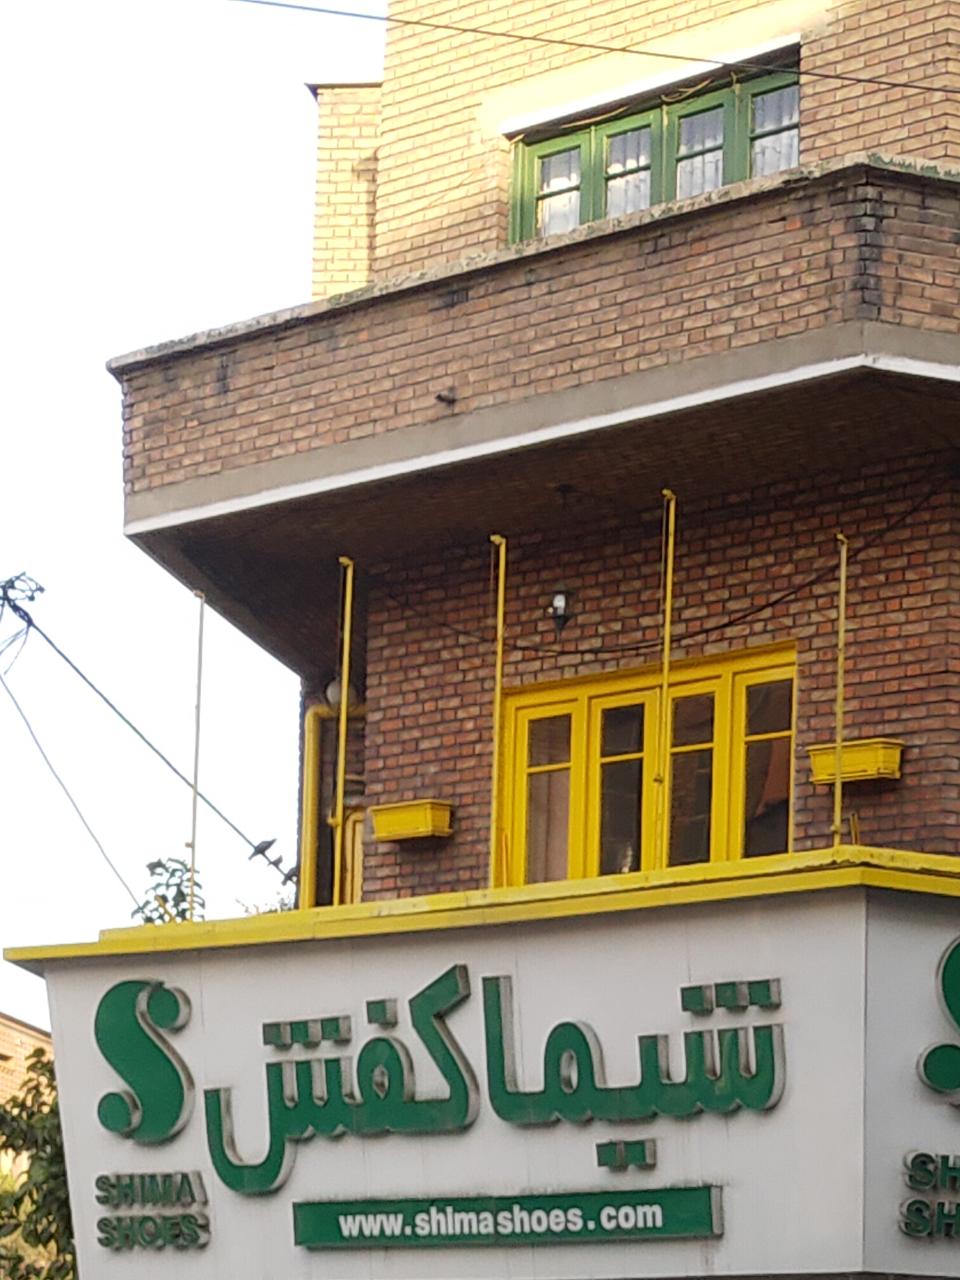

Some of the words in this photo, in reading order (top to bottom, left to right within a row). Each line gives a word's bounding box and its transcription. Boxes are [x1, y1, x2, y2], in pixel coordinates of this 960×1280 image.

[204, 963, 480, 1194] کفش
[482, 976, 783, 1170] شیما
[95, 1171, 208, 1207] SHIMA
[96, 1212, 211, 1250] SHOES
[339, 1203, 663, 1237] www.shimashoes.com
